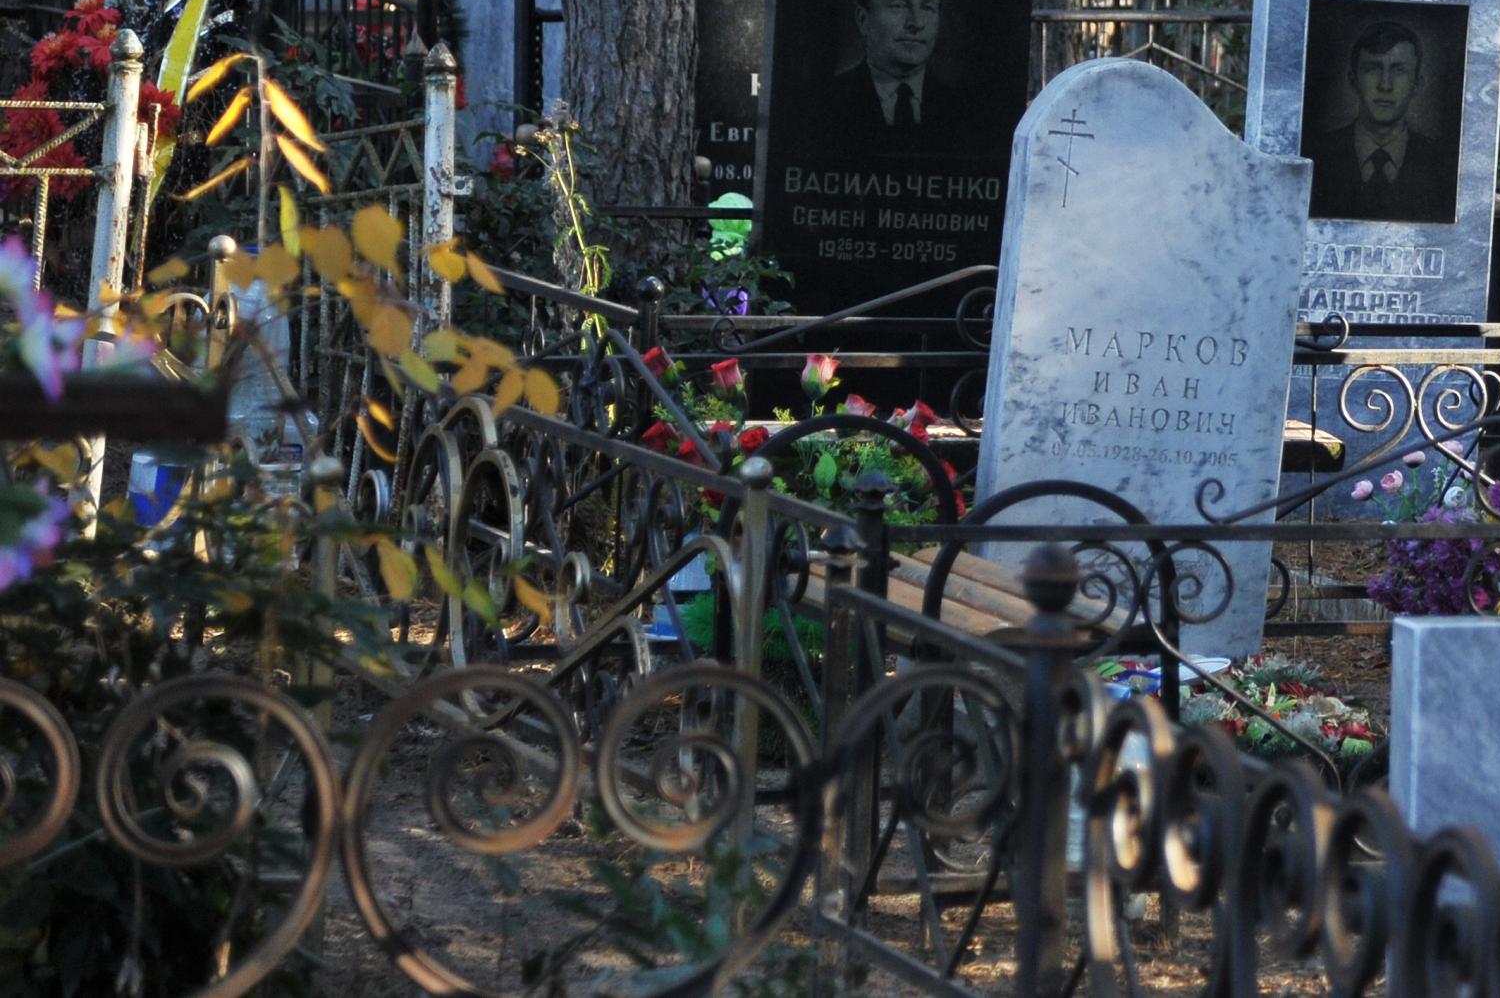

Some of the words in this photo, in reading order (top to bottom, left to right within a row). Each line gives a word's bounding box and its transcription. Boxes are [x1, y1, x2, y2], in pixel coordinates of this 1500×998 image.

[709, 121, 759, 143] Евг
[784, 166, 1001, 201] ВАСИЛЬЧЕНКО
[878, 208, 990, 232] ИВАНОВИЧ
[1064, 326, 1251, 367] МАРКОВ
[1092, 370, 1202, 401] ИВАН
[1059, 401, 1237, 435] ИВАНОВИЧ
